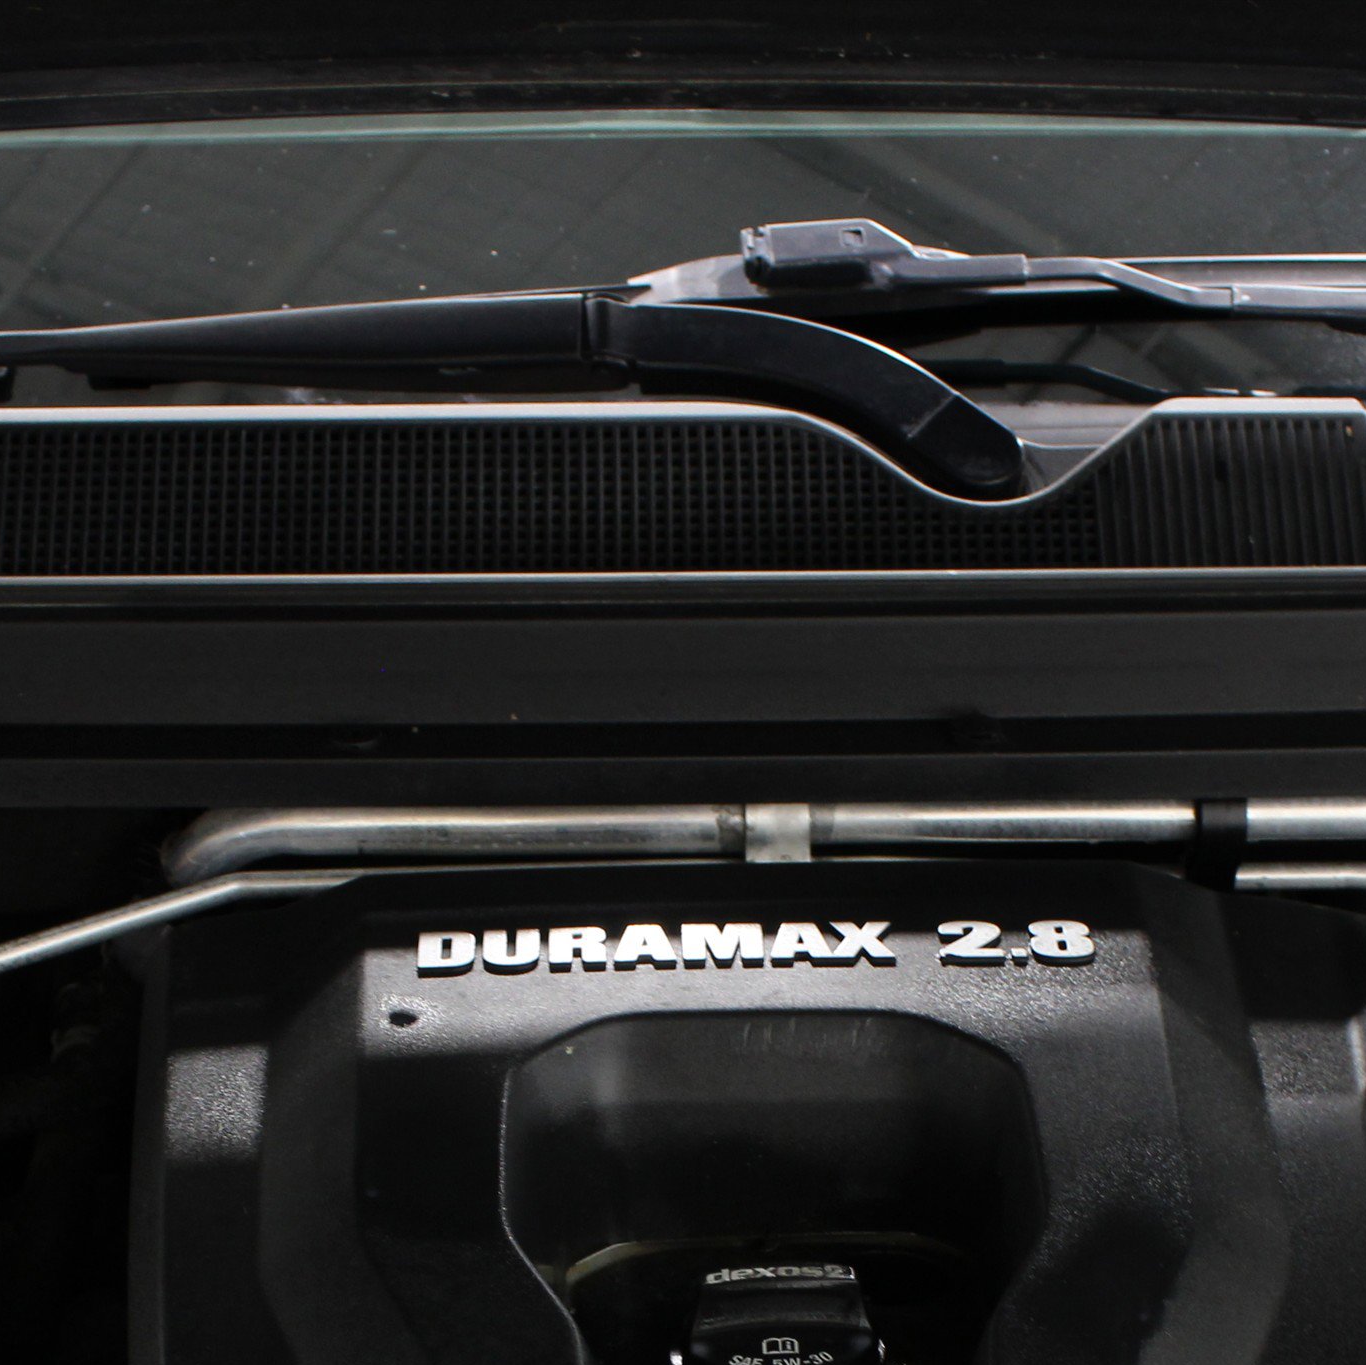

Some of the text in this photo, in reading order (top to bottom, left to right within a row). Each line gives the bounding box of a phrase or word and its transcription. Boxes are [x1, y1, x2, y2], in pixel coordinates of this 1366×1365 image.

[417, 920, 1096, 974] DURAMAX 2.8
[705, 1264, 849, 1285] dexos2
